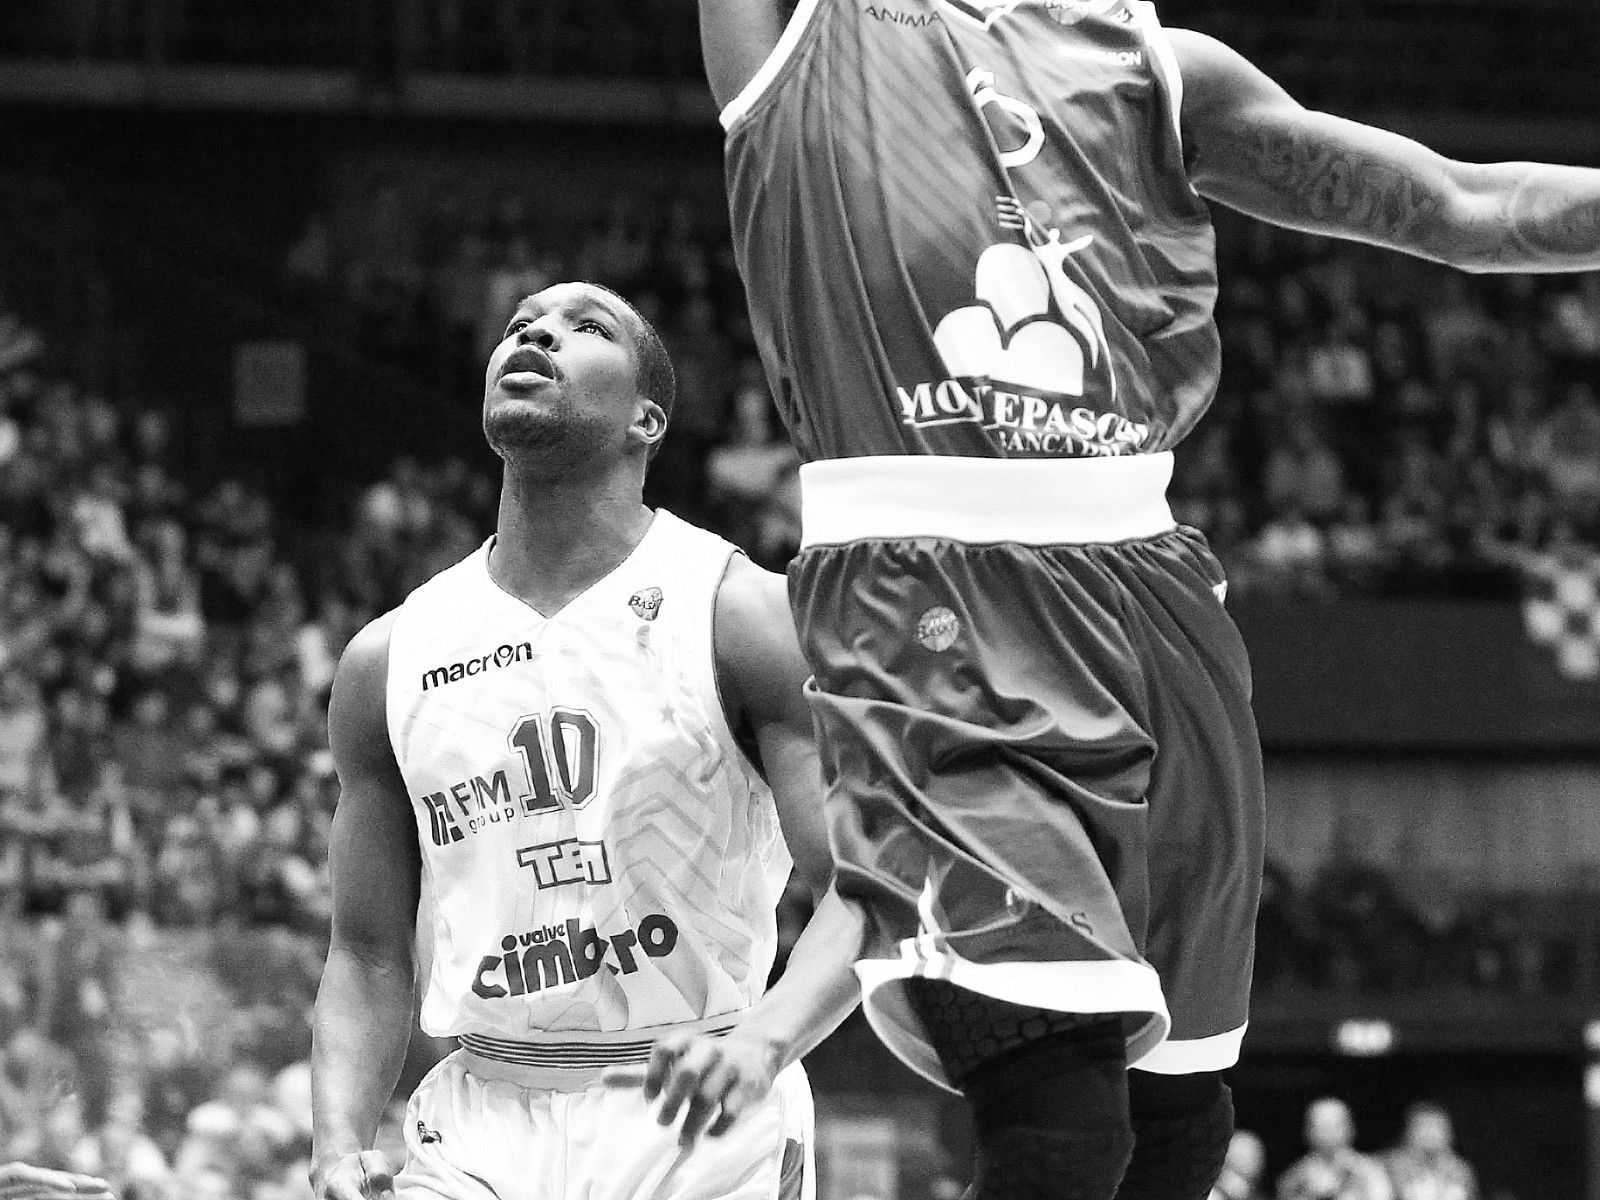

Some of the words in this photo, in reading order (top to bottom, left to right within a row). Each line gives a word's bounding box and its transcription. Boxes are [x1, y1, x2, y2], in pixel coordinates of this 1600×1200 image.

[422, 641, 532, 691] macron
[507, 705, 601, 817] 10
[519, 924, 566, 947] valve
